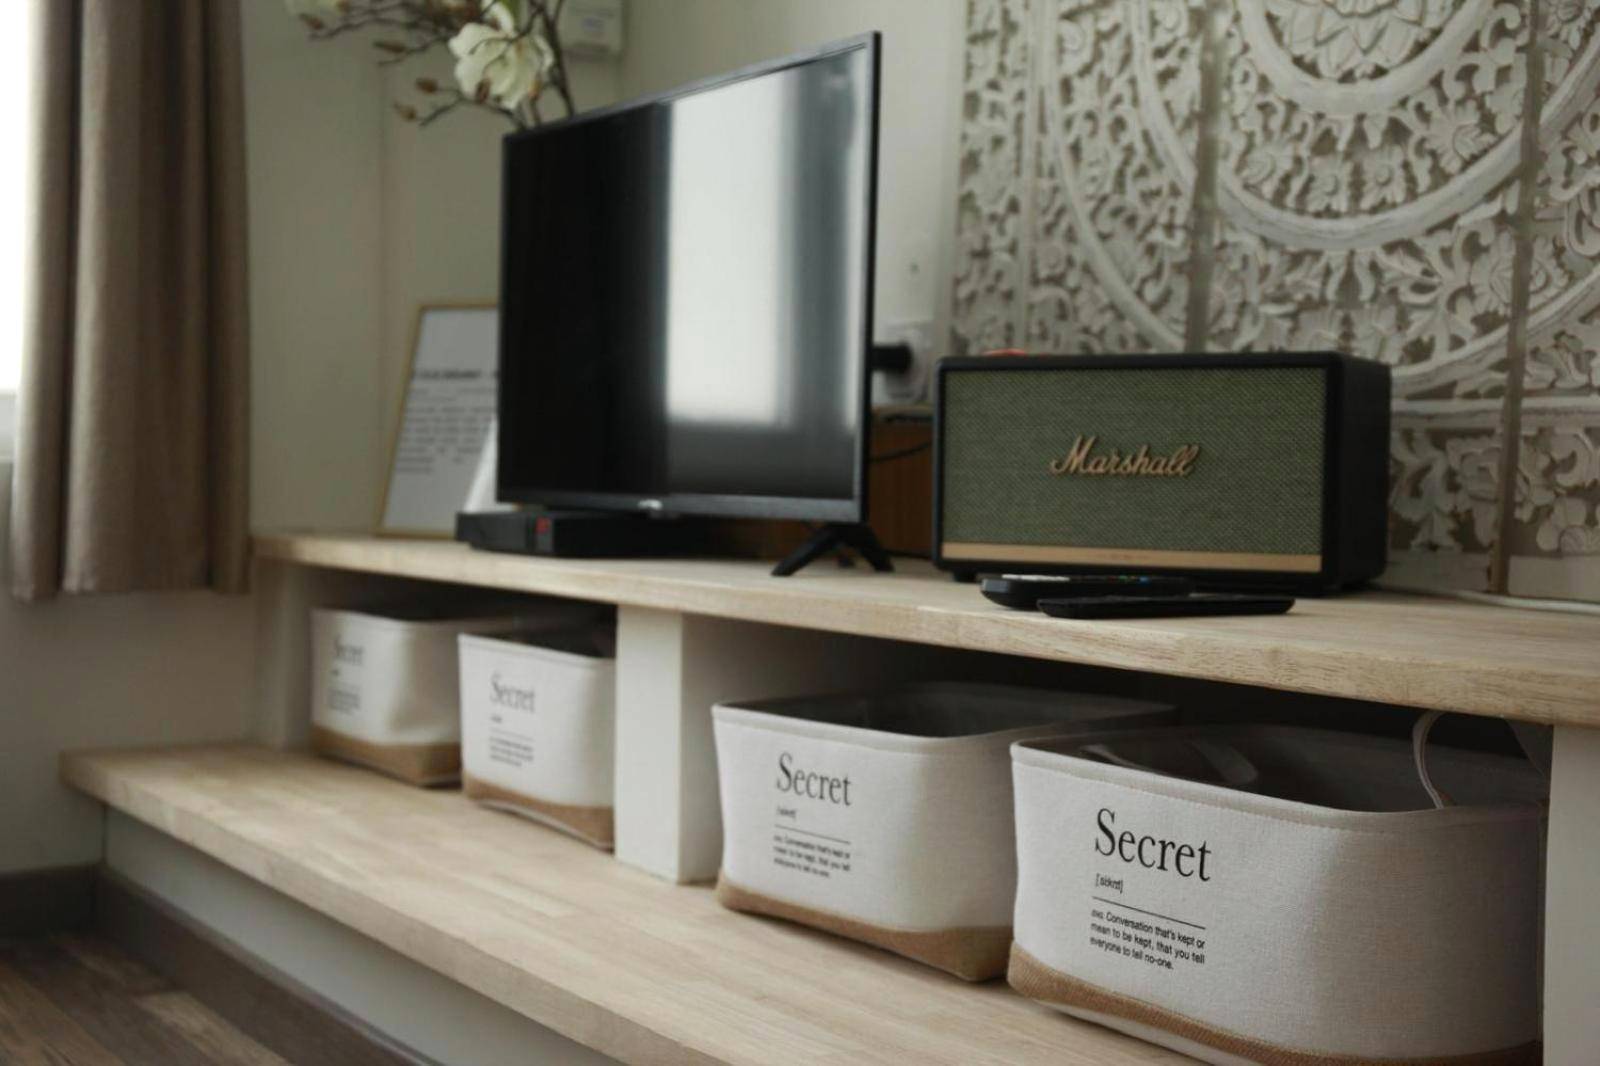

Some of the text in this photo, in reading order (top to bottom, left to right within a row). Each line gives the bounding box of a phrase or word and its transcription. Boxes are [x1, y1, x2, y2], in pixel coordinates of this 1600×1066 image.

[1051, 434, 1200, 476] Marshall
[489, 669, 535, 714] Secret
[776, 751, 851, 807] Secret
[1095, 807, 1212, 882] Secret
[1090, 936, 1122, 955] everyone
[1106, 911, 1153, 933] Conversation
[1155, 925, 1176, 941] that's
[1177, 931, 1195, 948] kept
[1196, 939, 1206, 949] or
[1112, 928, 1121, 939] to
[1122, 930, 1133, 942] be
[1156, 941, 1173, 955] that
[1174, 949, 1190, 960] you
[1191, 951, 1205, 964] tell
